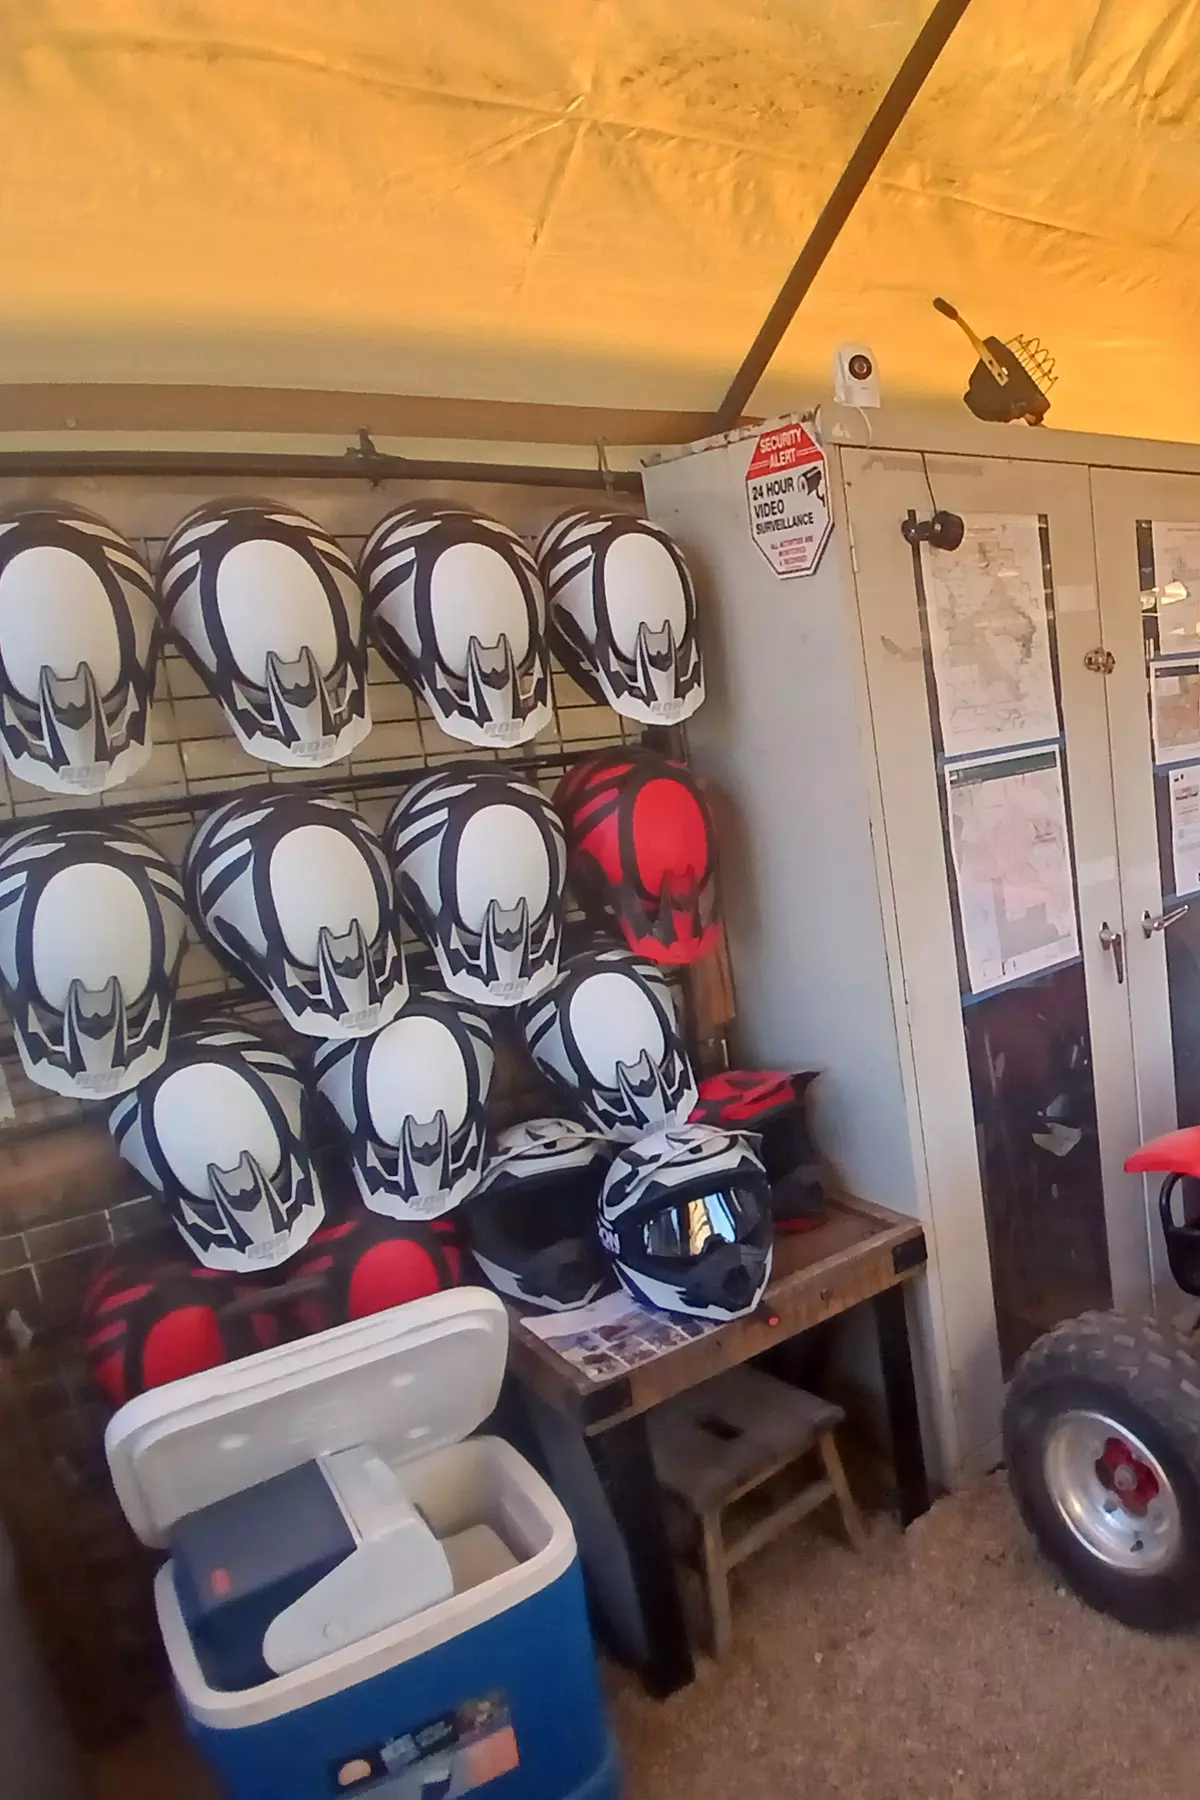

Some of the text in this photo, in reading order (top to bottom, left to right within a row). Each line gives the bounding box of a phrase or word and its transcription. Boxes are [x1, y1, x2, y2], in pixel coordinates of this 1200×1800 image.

[760, 428, 802, 454] SECURITY
[769, 448, 797, 469] ALERT
[752, 476, 795, 501] 24 HOUR
[753, 499, 785, 519] VIDEO
[756, 512, 814, 535] SURVEILLANCE
